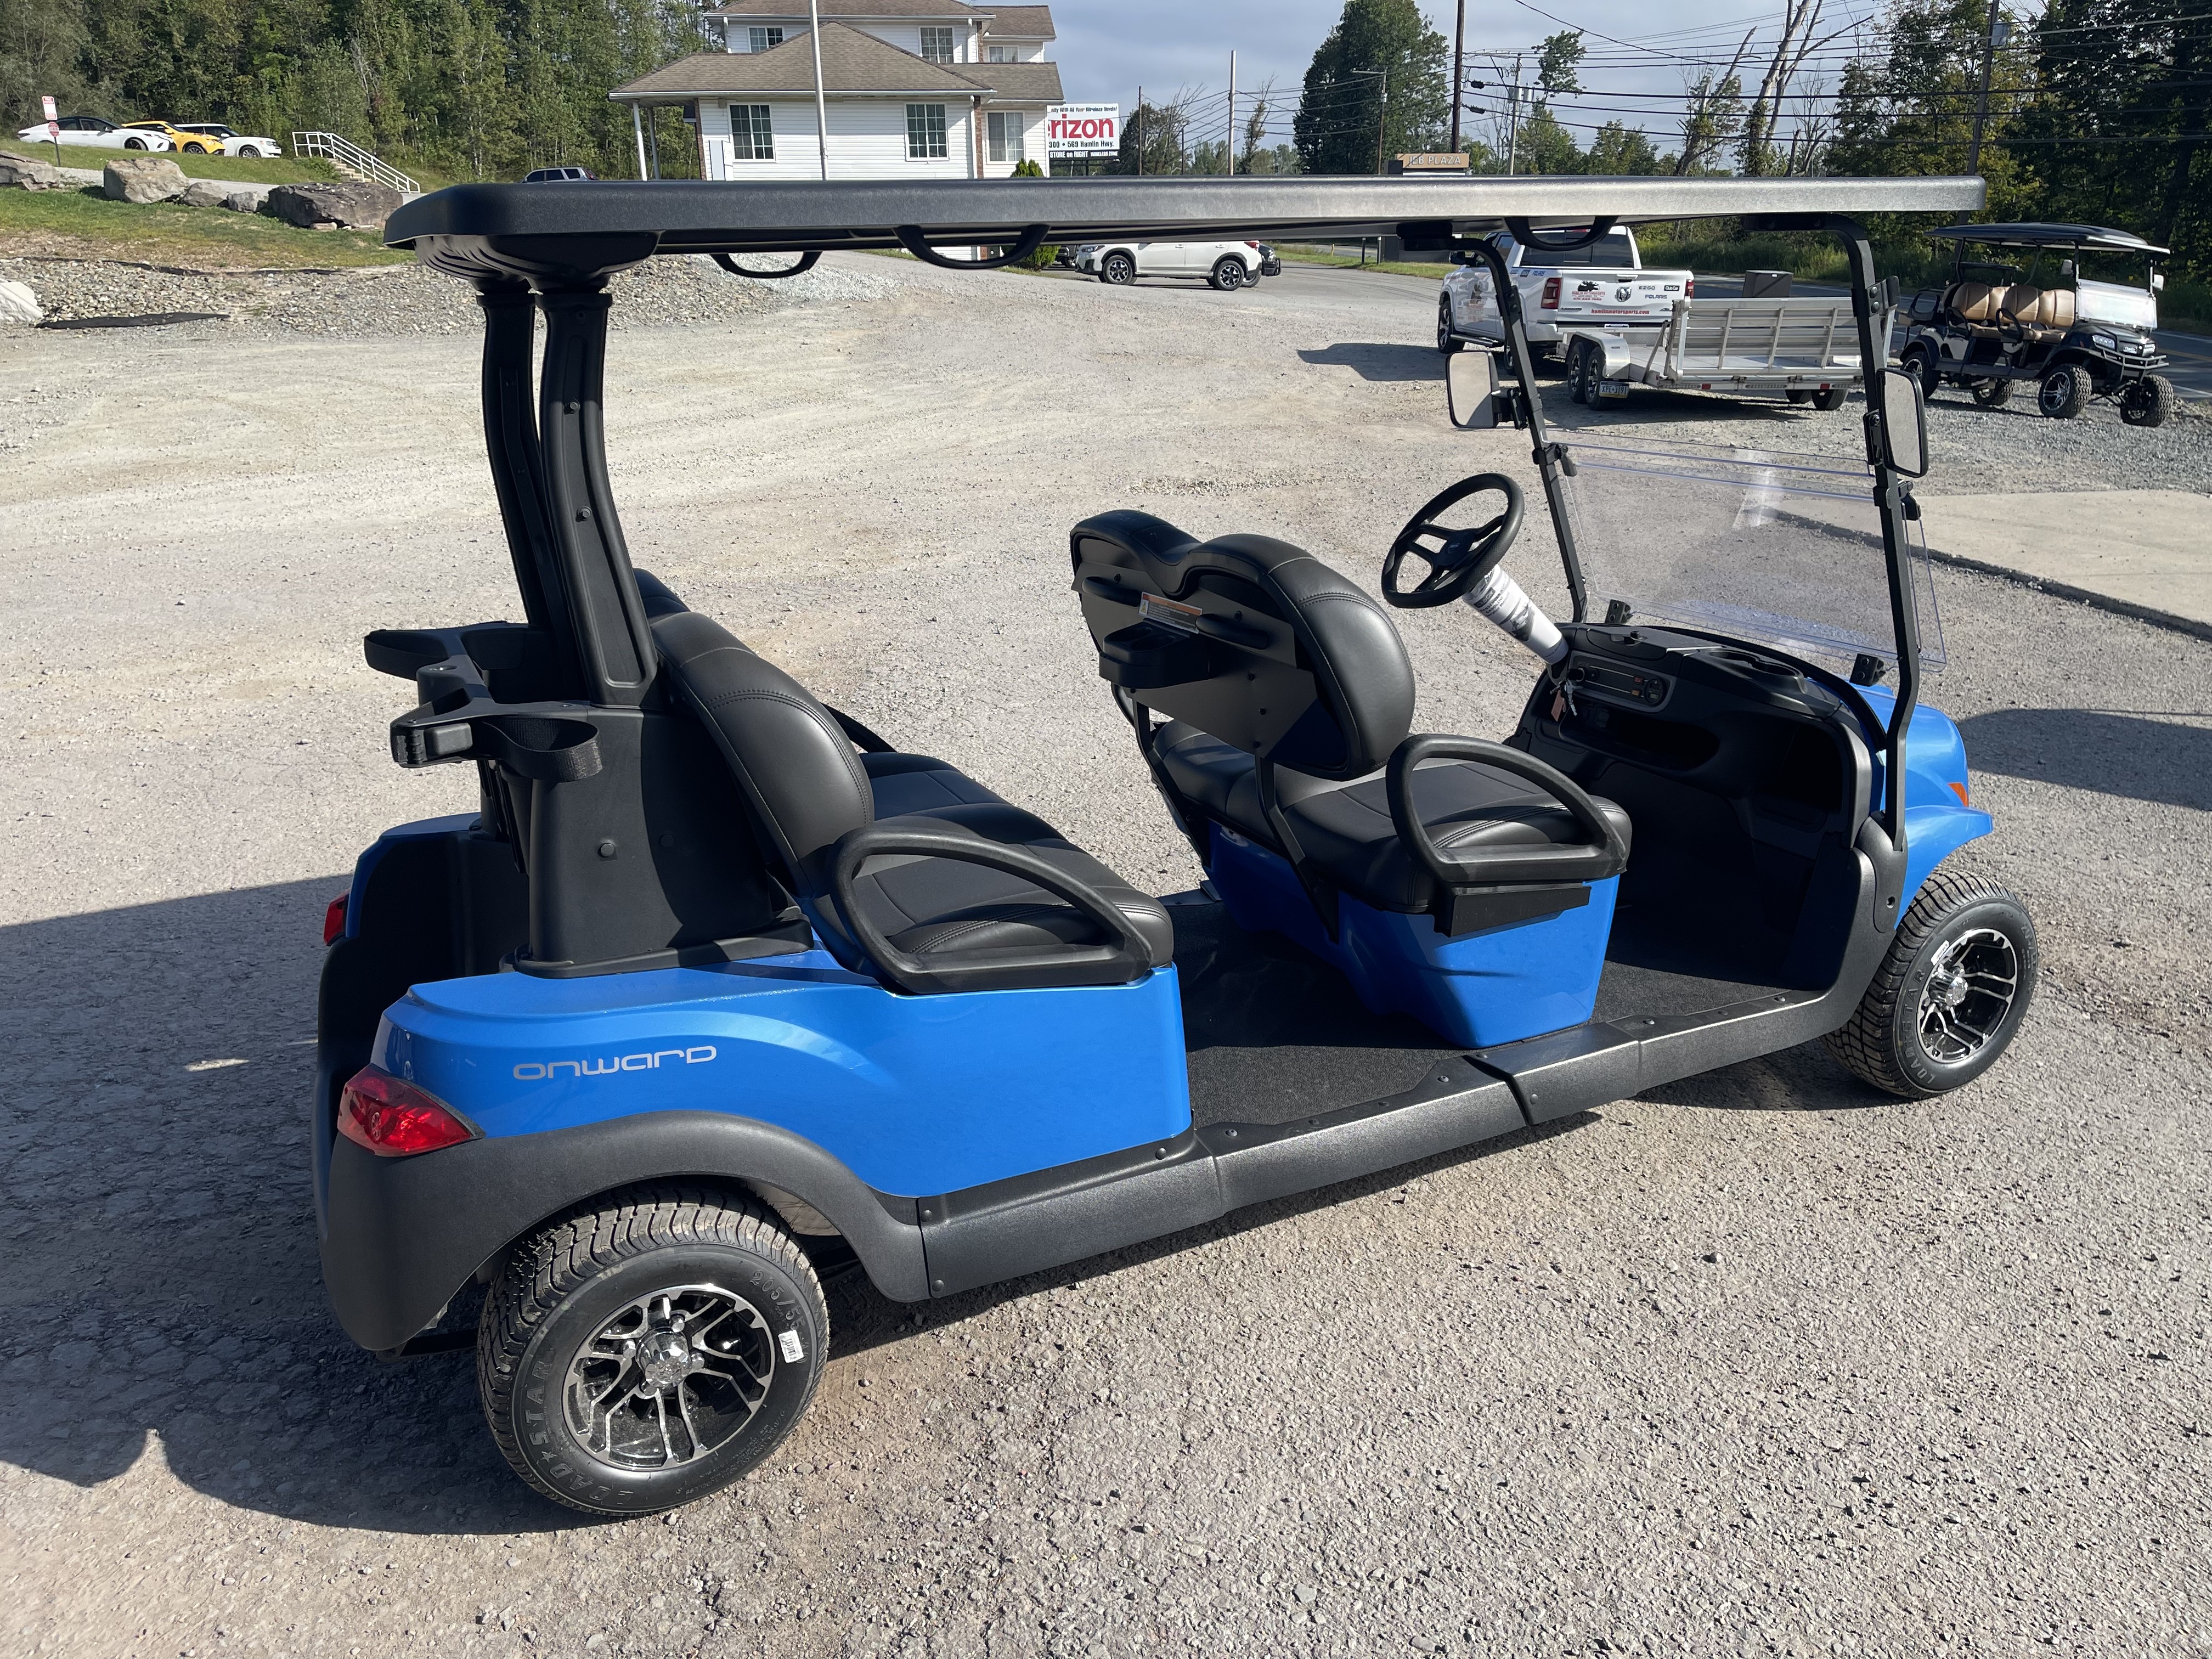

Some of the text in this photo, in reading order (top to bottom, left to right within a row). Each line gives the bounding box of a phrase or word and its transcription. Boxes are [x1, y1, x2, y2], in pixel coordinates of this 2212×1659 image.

[1048, 114, 1114, 138] rizon
[1428, 156, 1461, 165] PLAZA
[1905, 1047, 1936, 1084] LOAD
[525, 1360, 551, 1445] STAR
